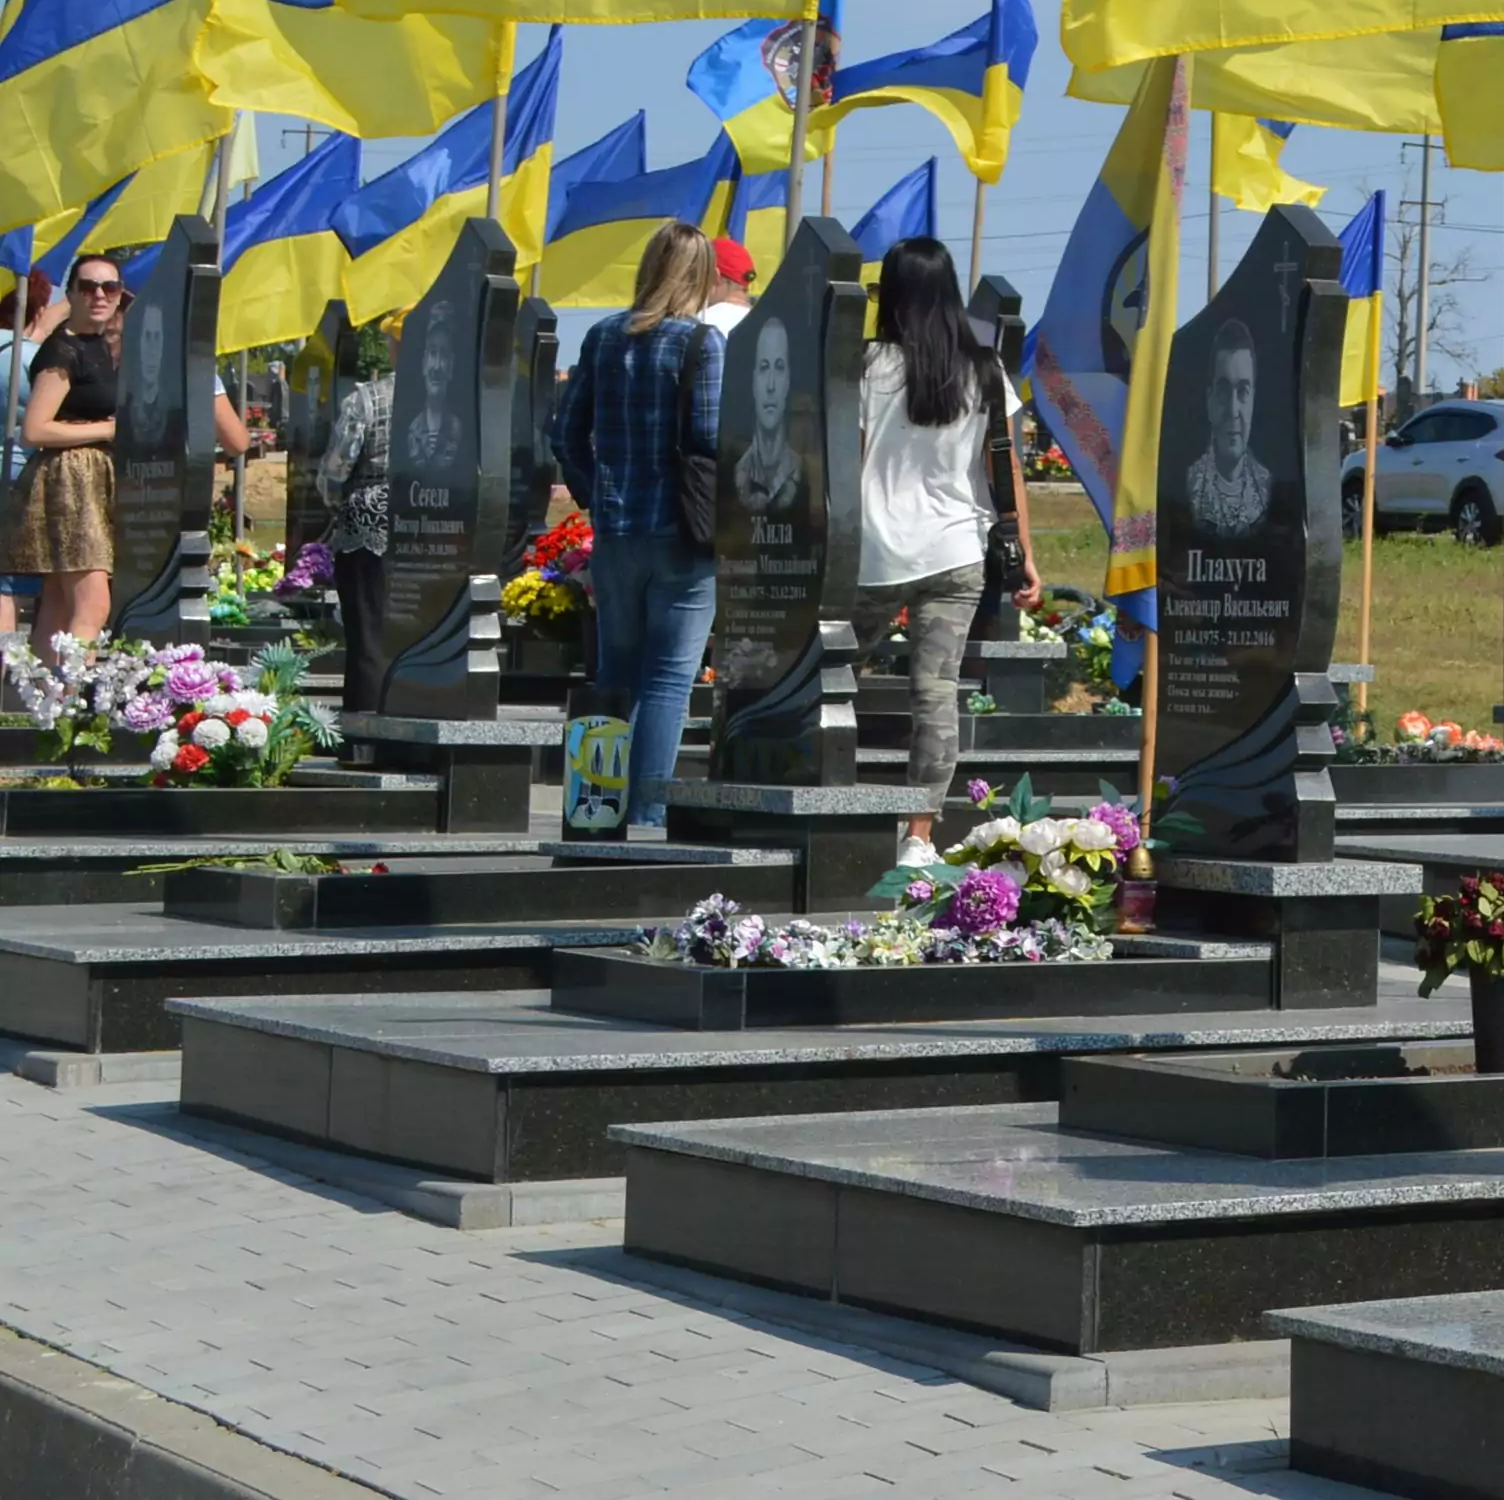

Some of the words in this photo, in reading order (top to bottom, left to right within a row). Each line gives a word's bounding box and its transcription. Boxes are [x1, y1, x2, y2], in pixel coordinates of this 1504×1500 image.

[751, 516, 793, 544] Жила
[1187, 549, 1267, 592] Плахута
[1164, 595, 1221, 623] Александр
[1223, 593, 1290, 618] Васильевич
